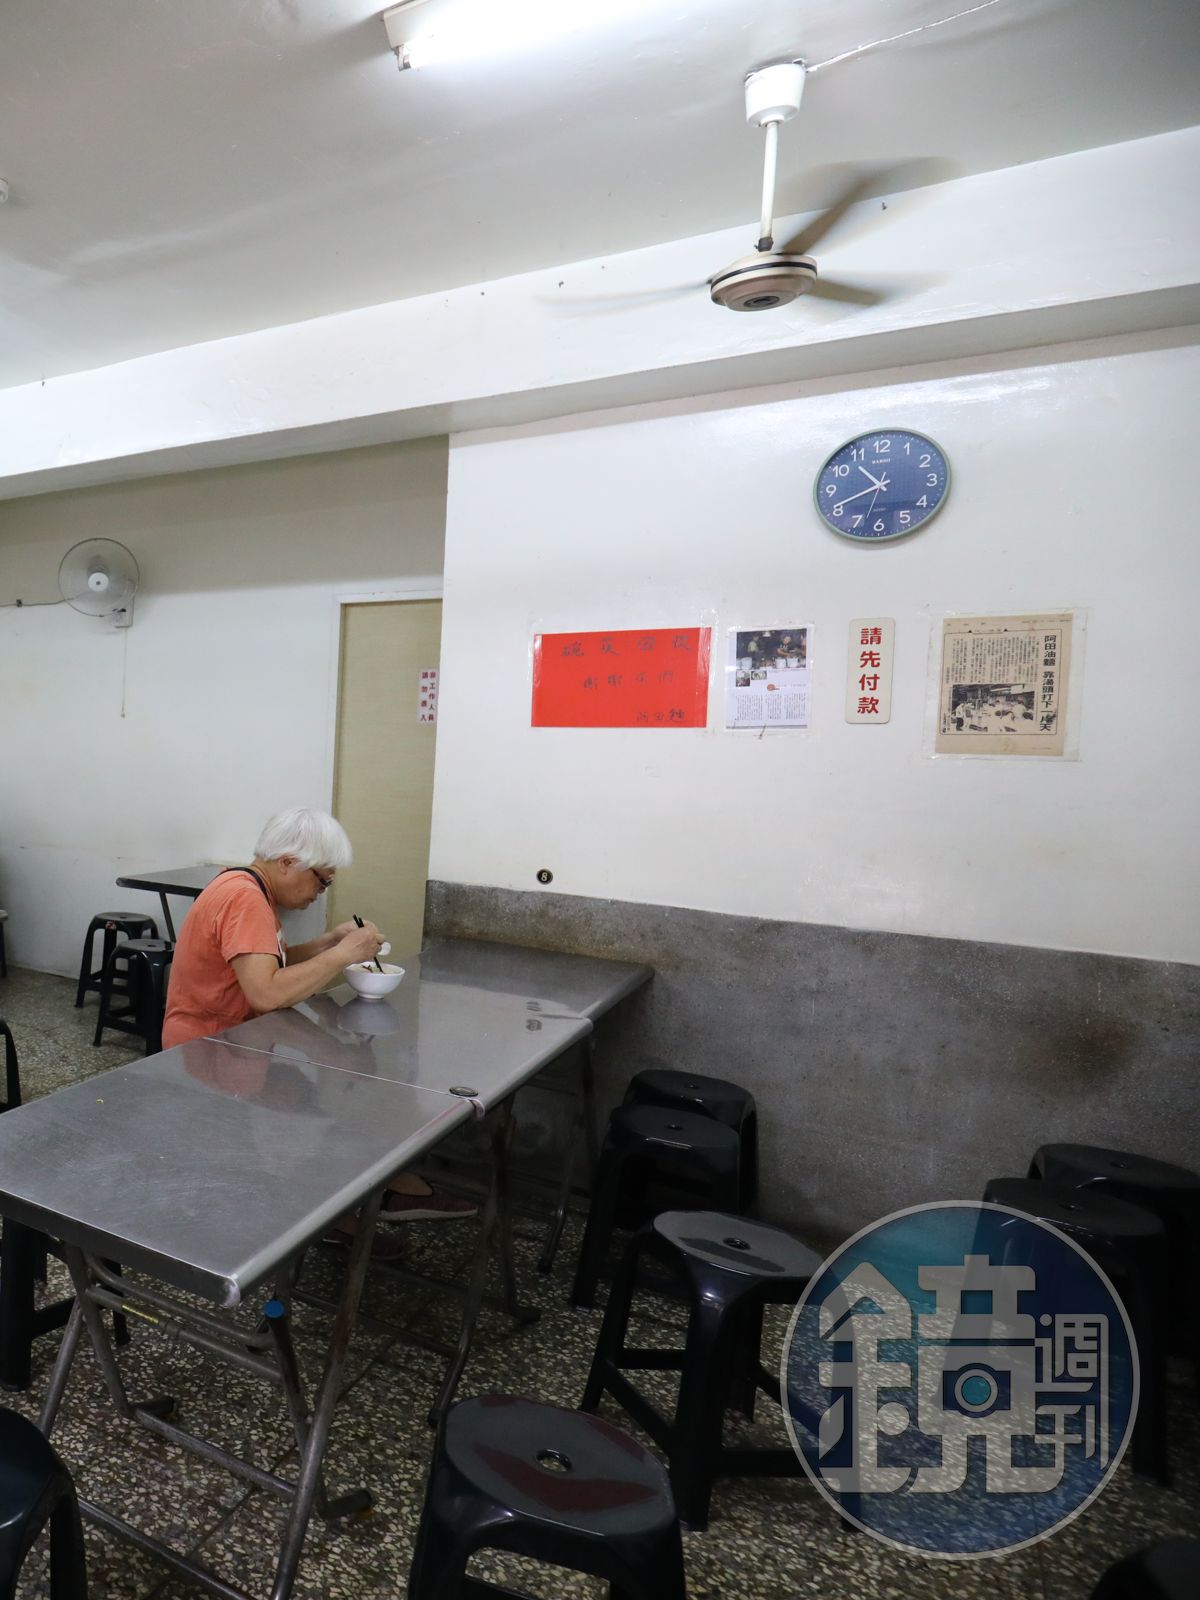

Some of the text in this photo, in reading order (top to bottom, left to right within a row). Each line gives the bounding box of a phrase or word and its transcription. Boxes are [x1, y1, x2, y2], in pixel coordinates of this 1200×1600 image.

[873, 439, 891, 454] 12
[903, 442, 910, 455] 1
[851, 448, 865, 462] 11
[919, 454, 931, 468] 2
[832, 464, 849, 478] 10
[926, 473, 938, 487] 3
[825, 484, 837, 498] 9
[916, 494, 928, 508] 4
[832, 504, 844, 517] 8
[899, 510, 911, 524] 5
[851, 515, 863, 528] 7
[873, 518, 885, 532] 6
[857, 627, 882, 714] 請先付款
